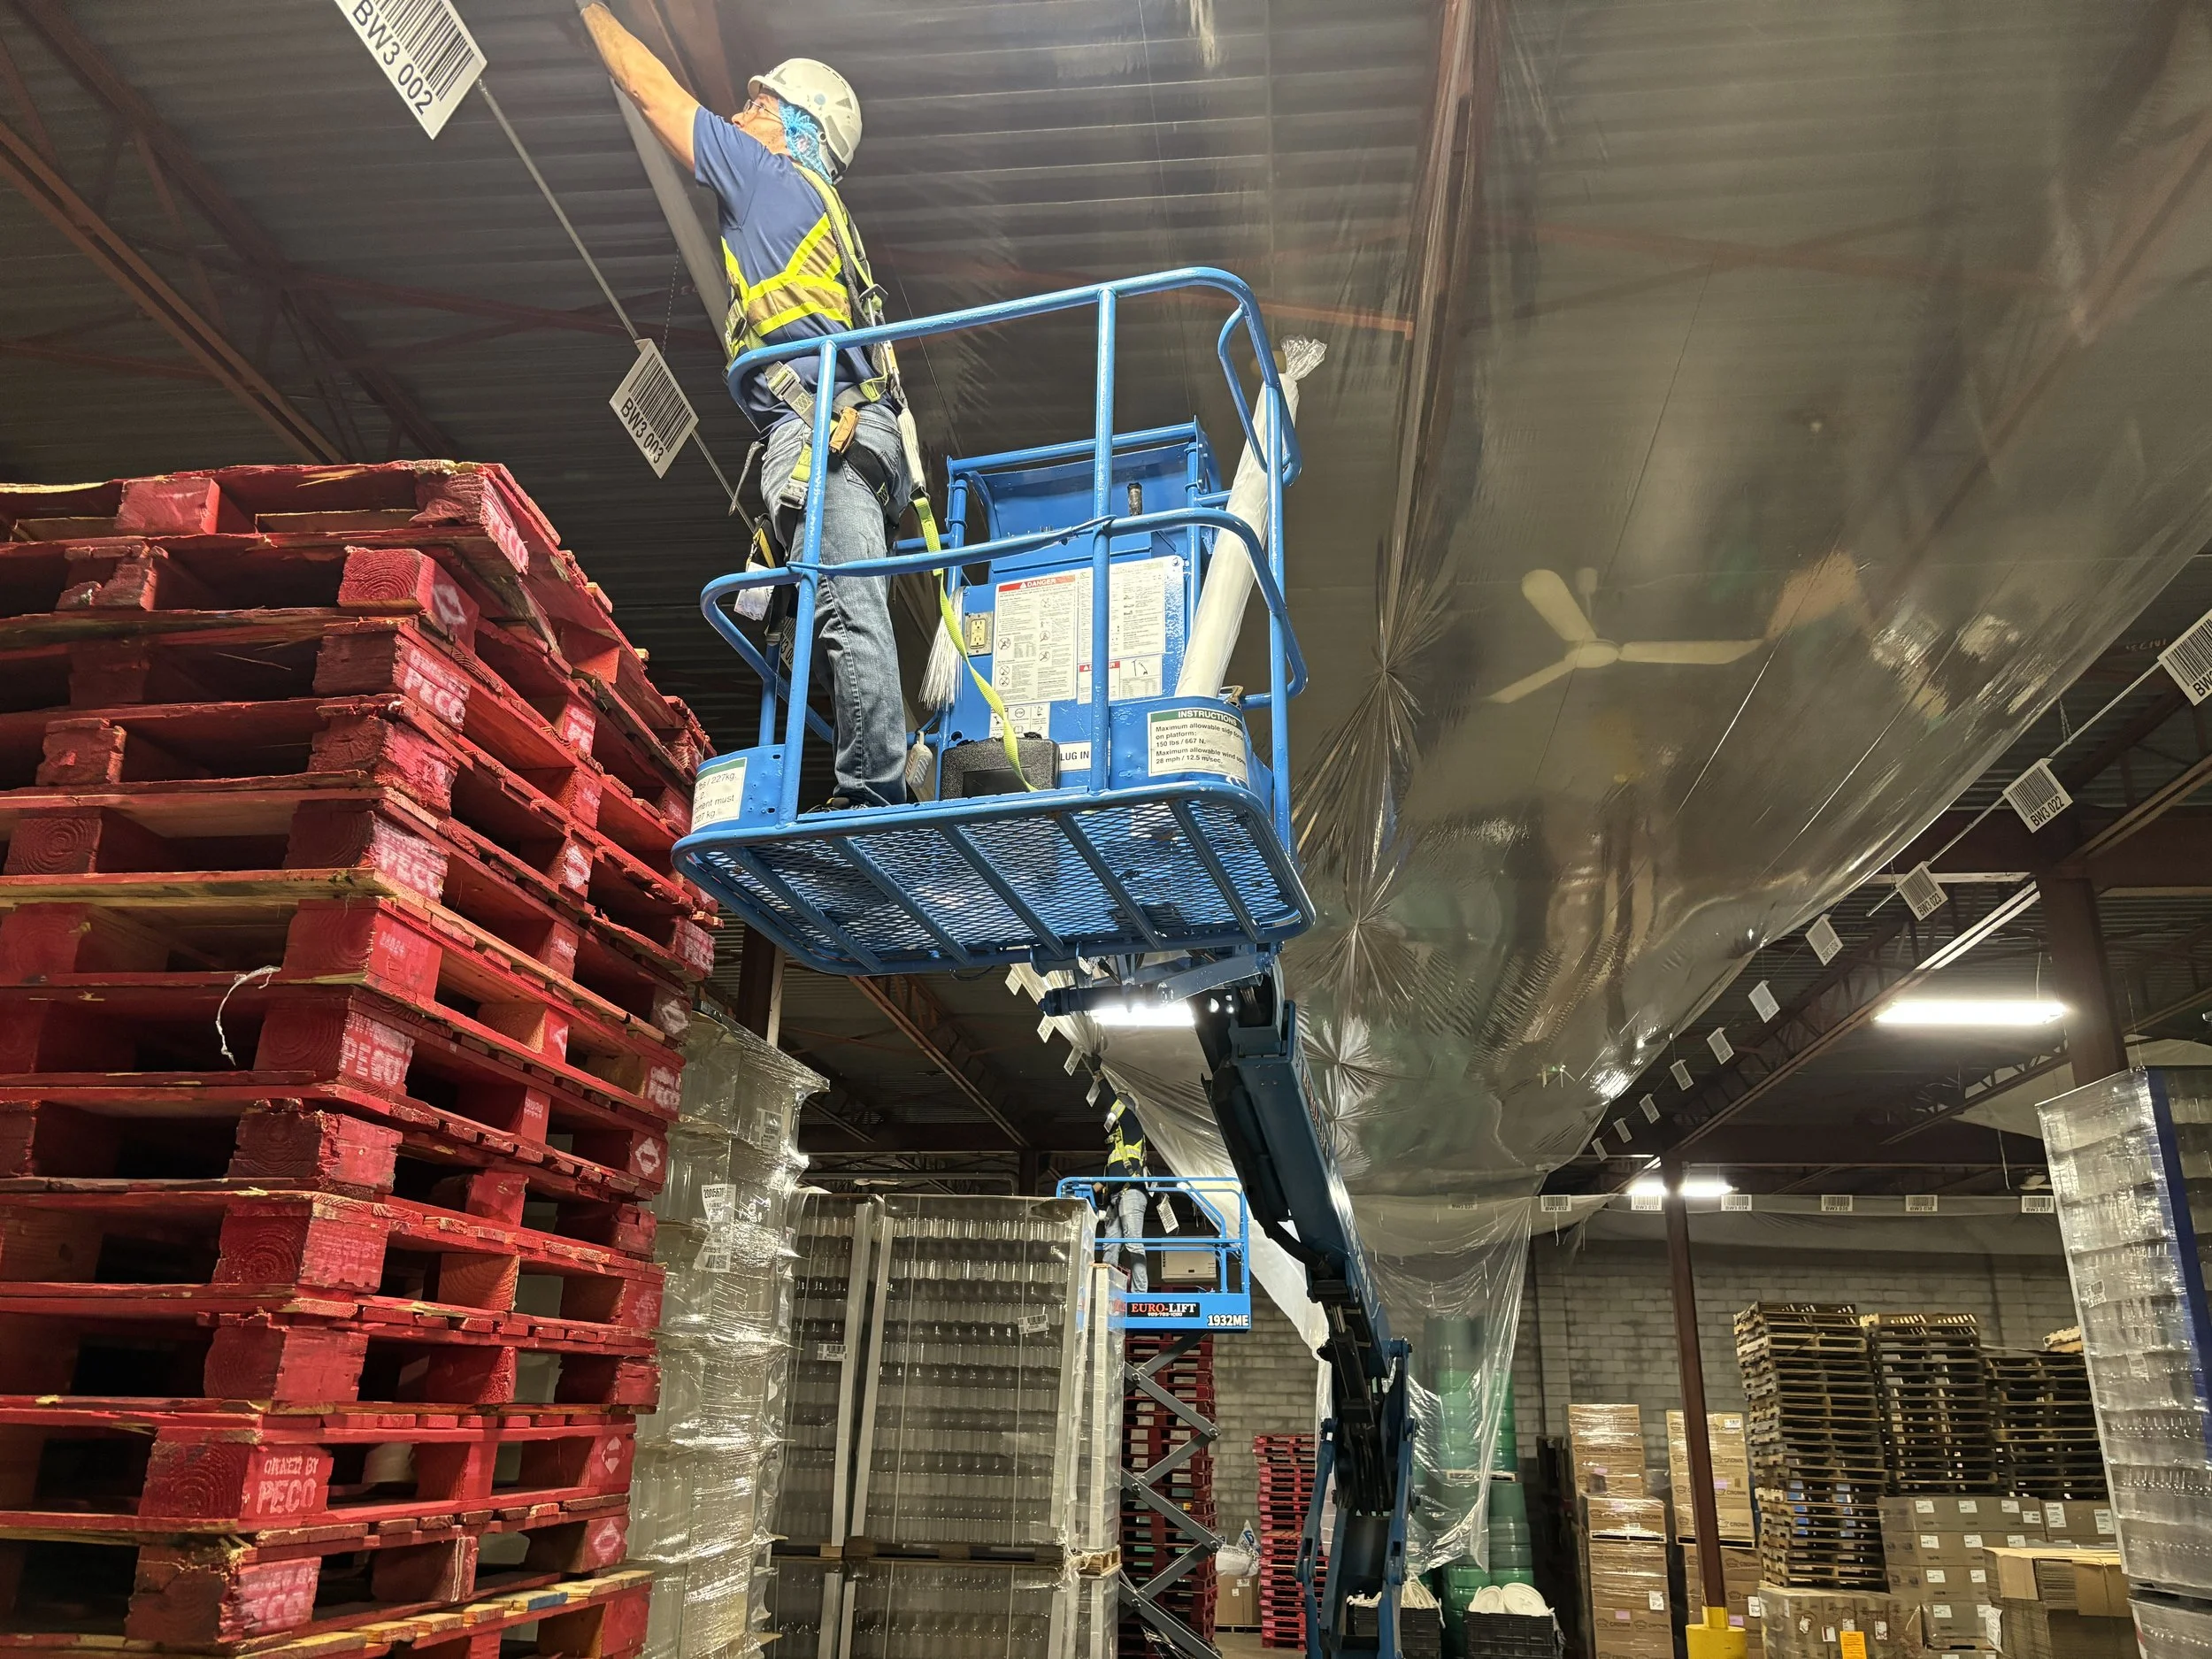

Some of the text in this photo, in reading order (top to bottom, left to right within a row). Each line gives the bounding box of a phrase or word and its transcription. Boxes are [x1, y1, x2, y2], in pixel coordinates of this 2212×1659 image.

[352, 0, 434, 116] BW3 002
[620, 397, 647, 438] BW3
[1026, 578, 1056, 588] DANGER
[2193, 670, 2212, 697] BW
[1178, 710, 1238, 726] INSTRUCTIONS
[1156, 724, 1188, 733] Maximum
[1190, 722, 1220, 732] allowable
[1221, 726, 1233, 736] side
[1165, 731, 1197, 741] platform:
[1060, 750, 1089, 762] LUG IN
[1156, 748, 1188, 757] Maximum
[1189, 746, 1221, 756] allowable
[1222, 751, 1236, 760] wind
[1165, 756, 1180, 764] mph
[714, 795, 734, 806] must
[2030, 795, 2065, 826] BW3 022
[1917, 893, 1943, 917] BW3 023
[1131, 1302, 1196, 1313] EURO-LIFT
[1207, 1314, 1249, 1326] 1932ME
[256, 1478, 318, 1515] PECO
